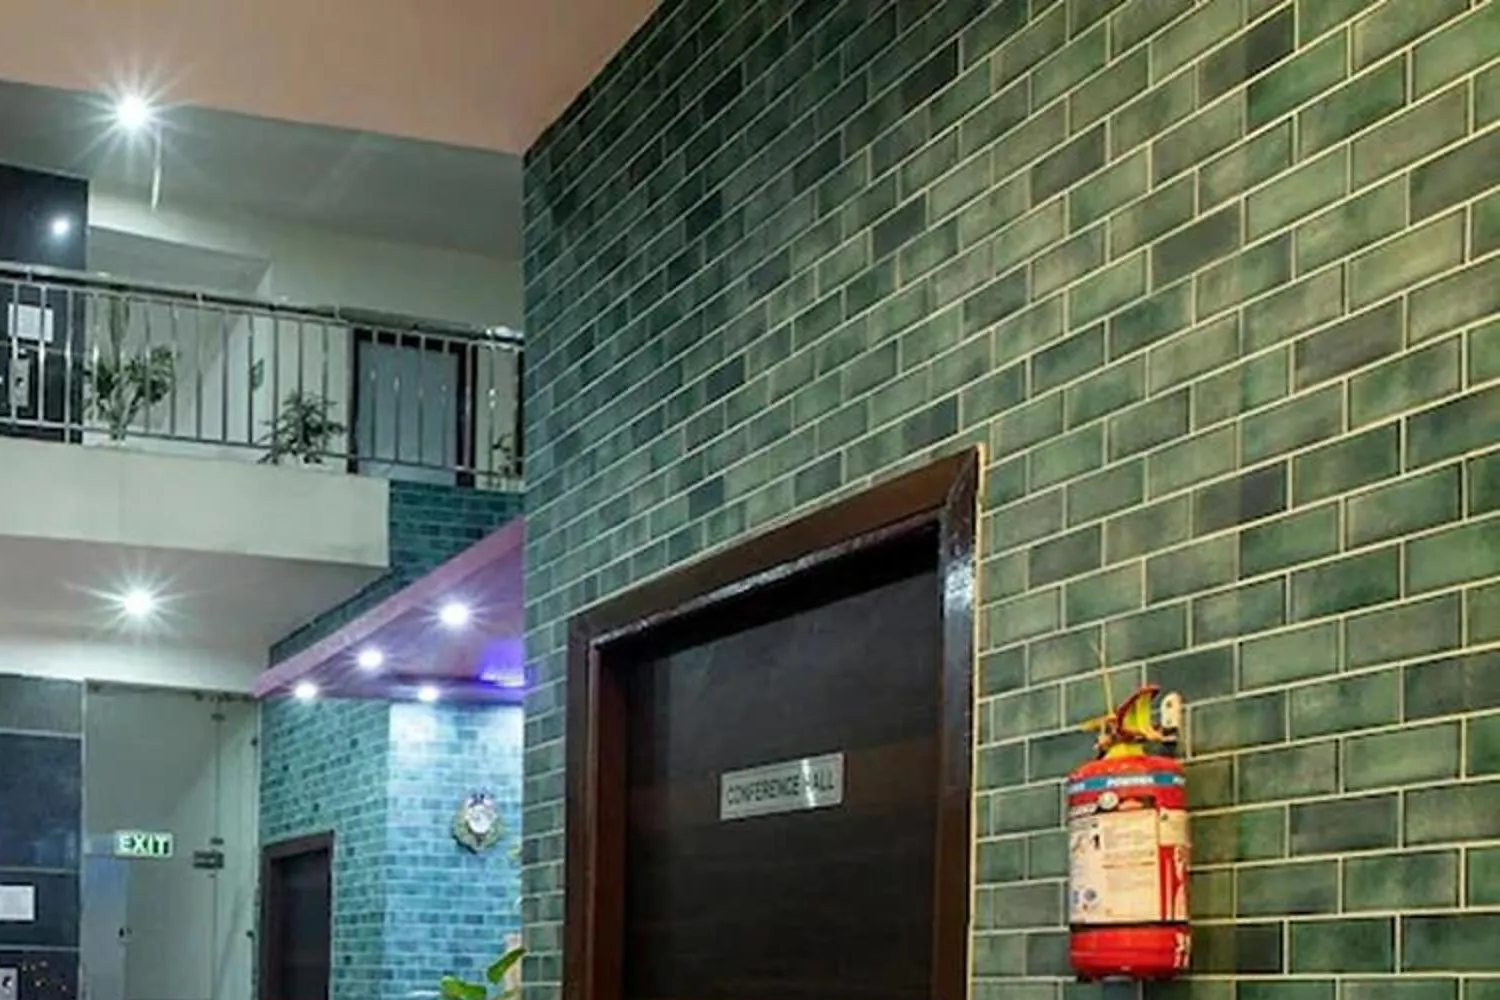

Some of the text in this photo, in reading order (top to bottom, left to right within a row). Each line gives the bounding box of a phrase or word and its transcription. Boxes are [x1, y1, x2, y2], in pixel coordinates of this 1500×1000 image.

[728, 770, 835, 805] CONFERENCE ALL
[120, 833, 169, 854] EXIT
